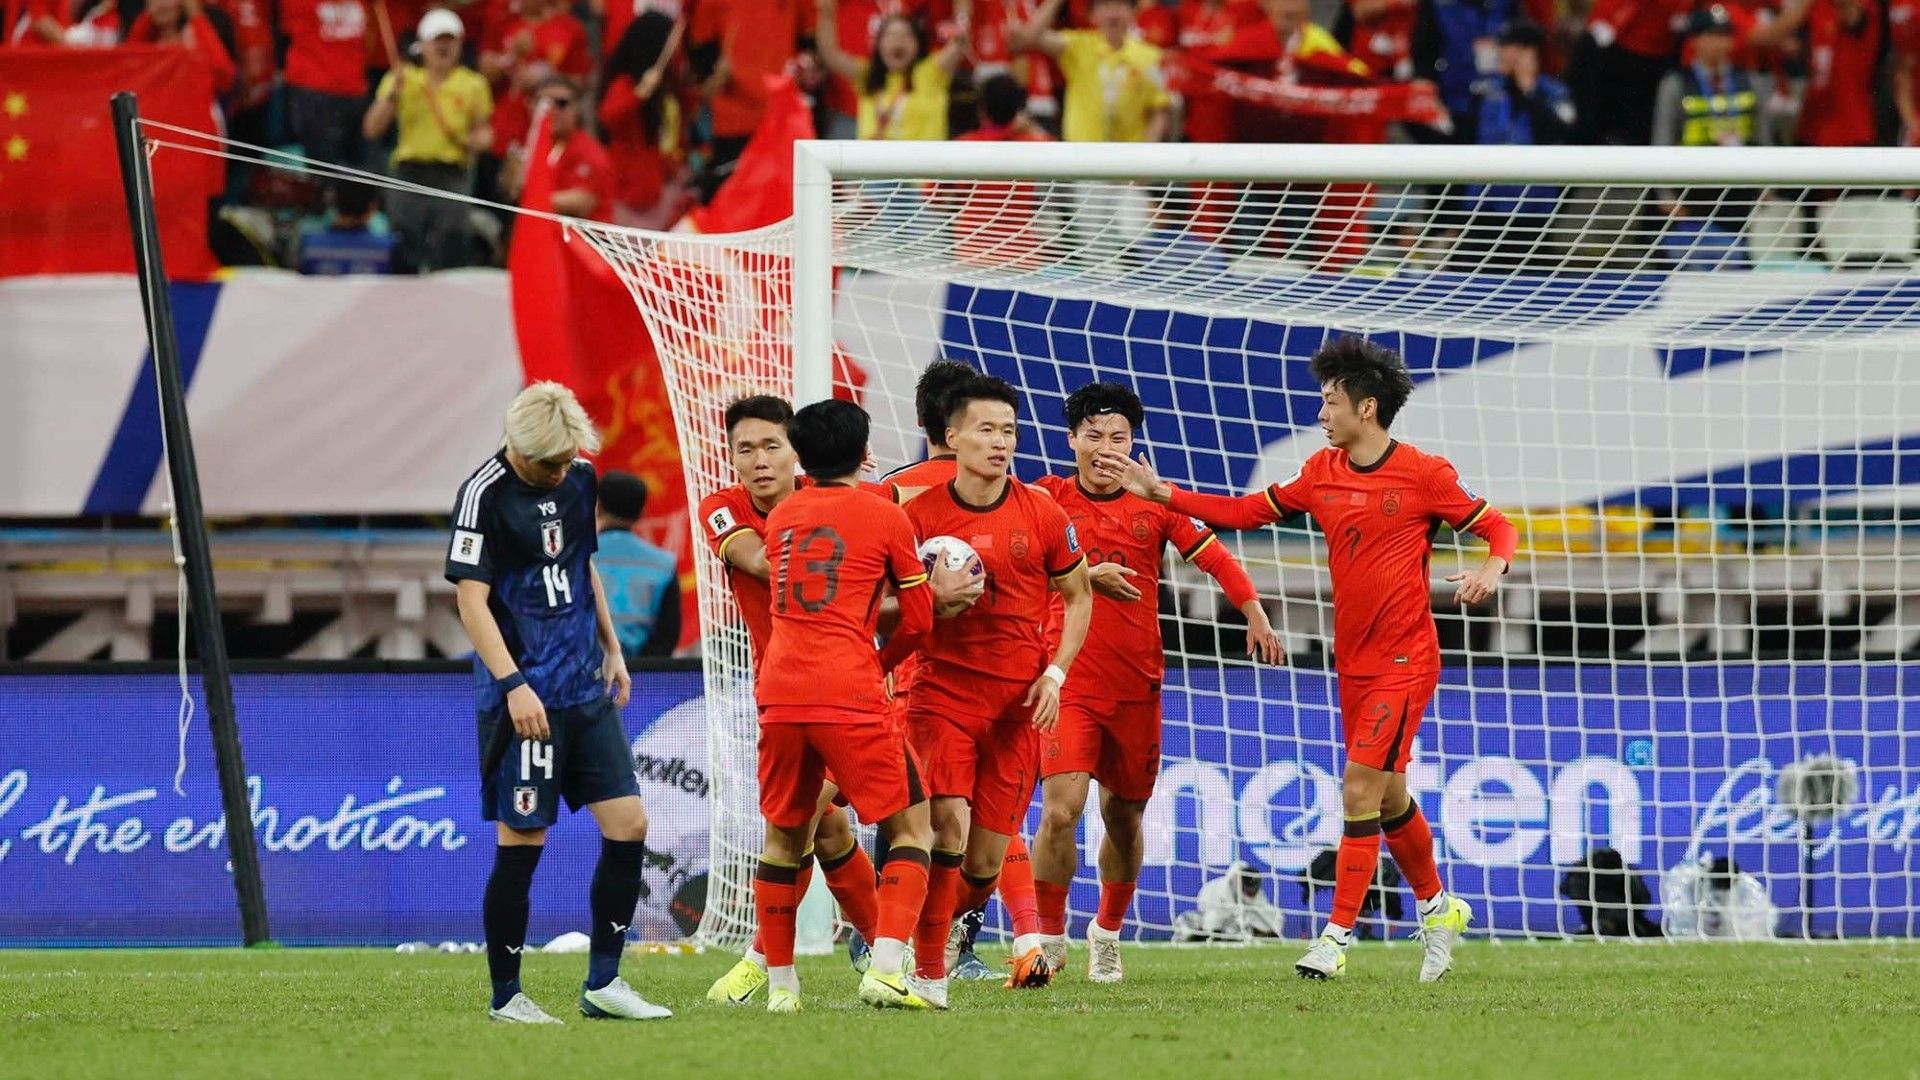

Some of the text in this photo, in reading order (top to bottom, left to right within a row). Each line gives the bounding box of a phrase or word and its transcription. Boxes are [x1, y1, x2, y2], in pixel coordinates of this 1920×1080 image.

[542, 563, 573, 608] 14
[776, 526, 846, 613] 13
[1371, 702, 1391, 738] 7
[520, 739, 554, 781] 14
[22, 786, 157, 864] the
